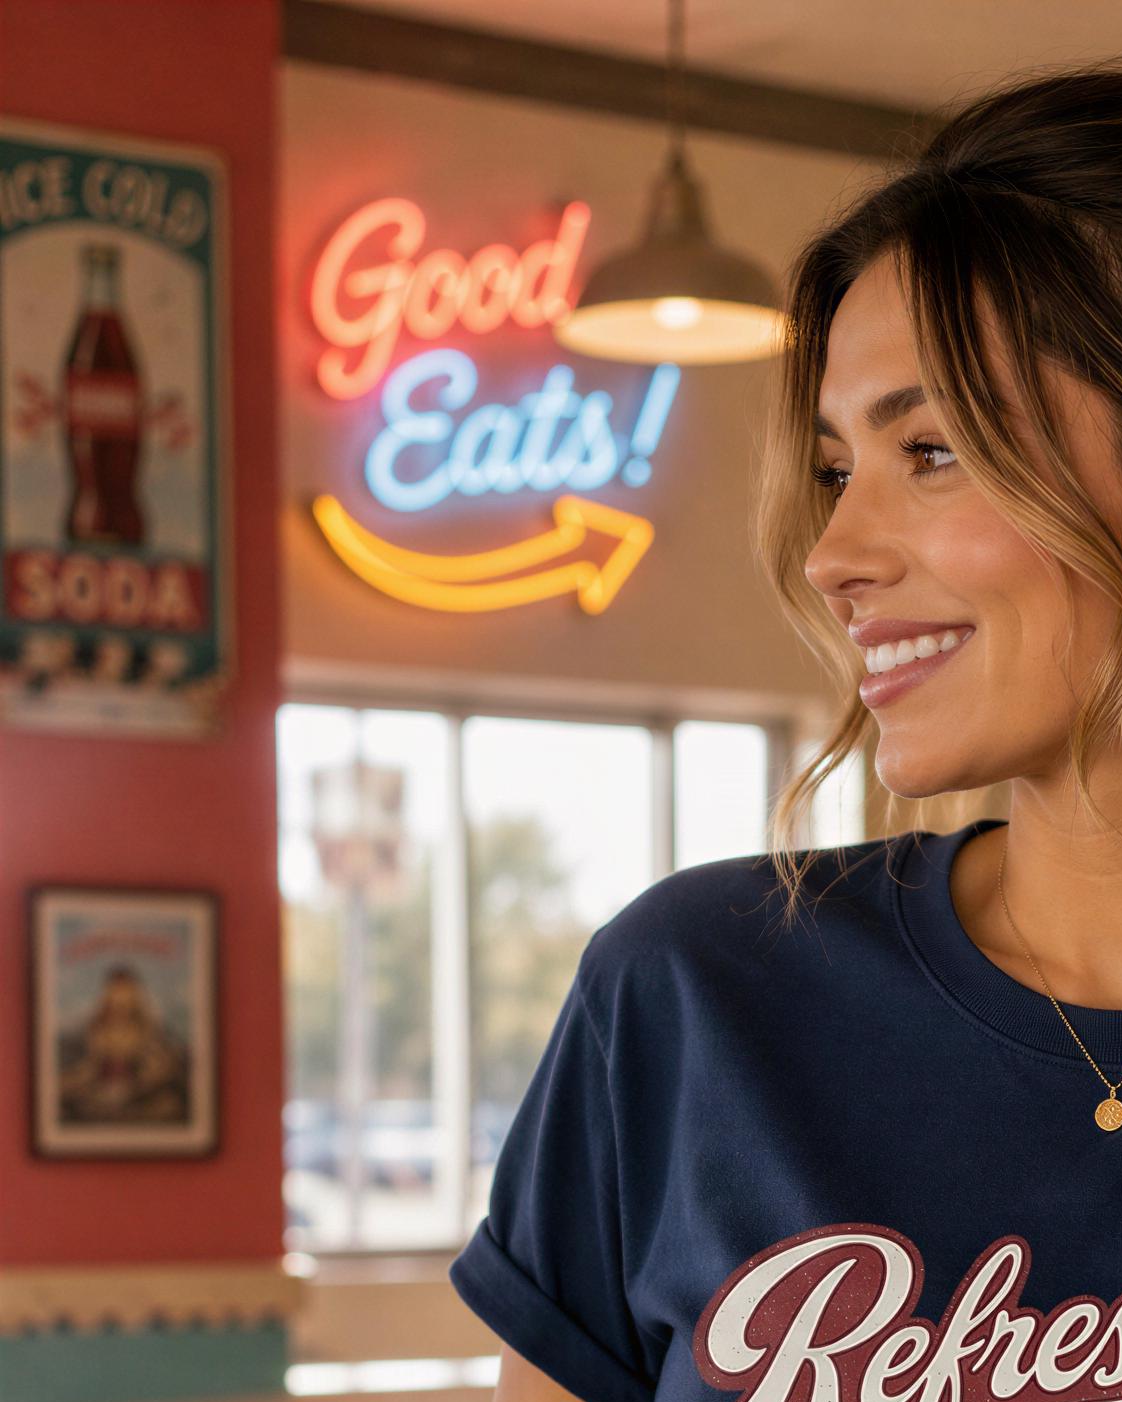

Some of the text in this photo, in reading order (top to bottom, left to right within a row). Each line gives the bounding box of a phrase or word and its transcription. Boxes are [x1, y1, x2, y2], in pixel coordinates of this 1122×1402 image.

[312, 198, 592, 400] Good
[364, 348, 681, 512] Eats!
[16, 550, 199, 628] SODA
